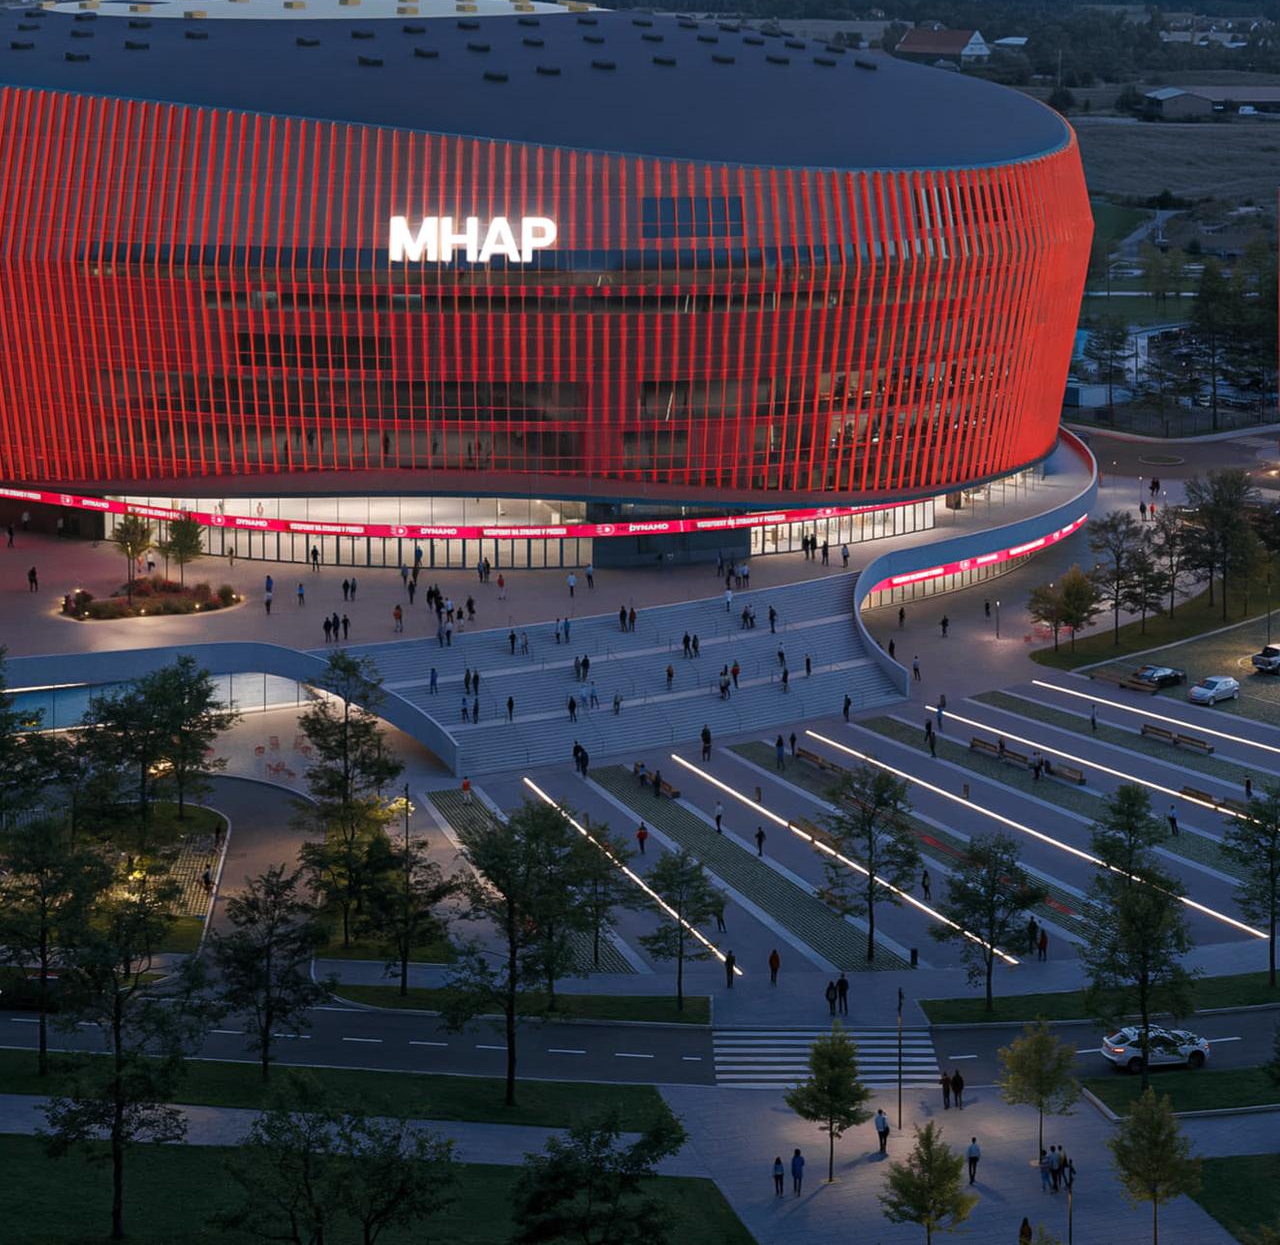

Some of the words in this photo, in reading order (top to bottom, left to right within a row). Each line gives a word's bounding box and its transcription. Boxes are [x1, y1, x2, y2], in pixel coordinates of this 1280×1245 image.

[389, 216, 558, 263] MHAP
[236, 517, 268, 527] DYNAMO
[629, 522, 670, 532] DYNAMO
[420, 527, 458, 536] DYNAMO
